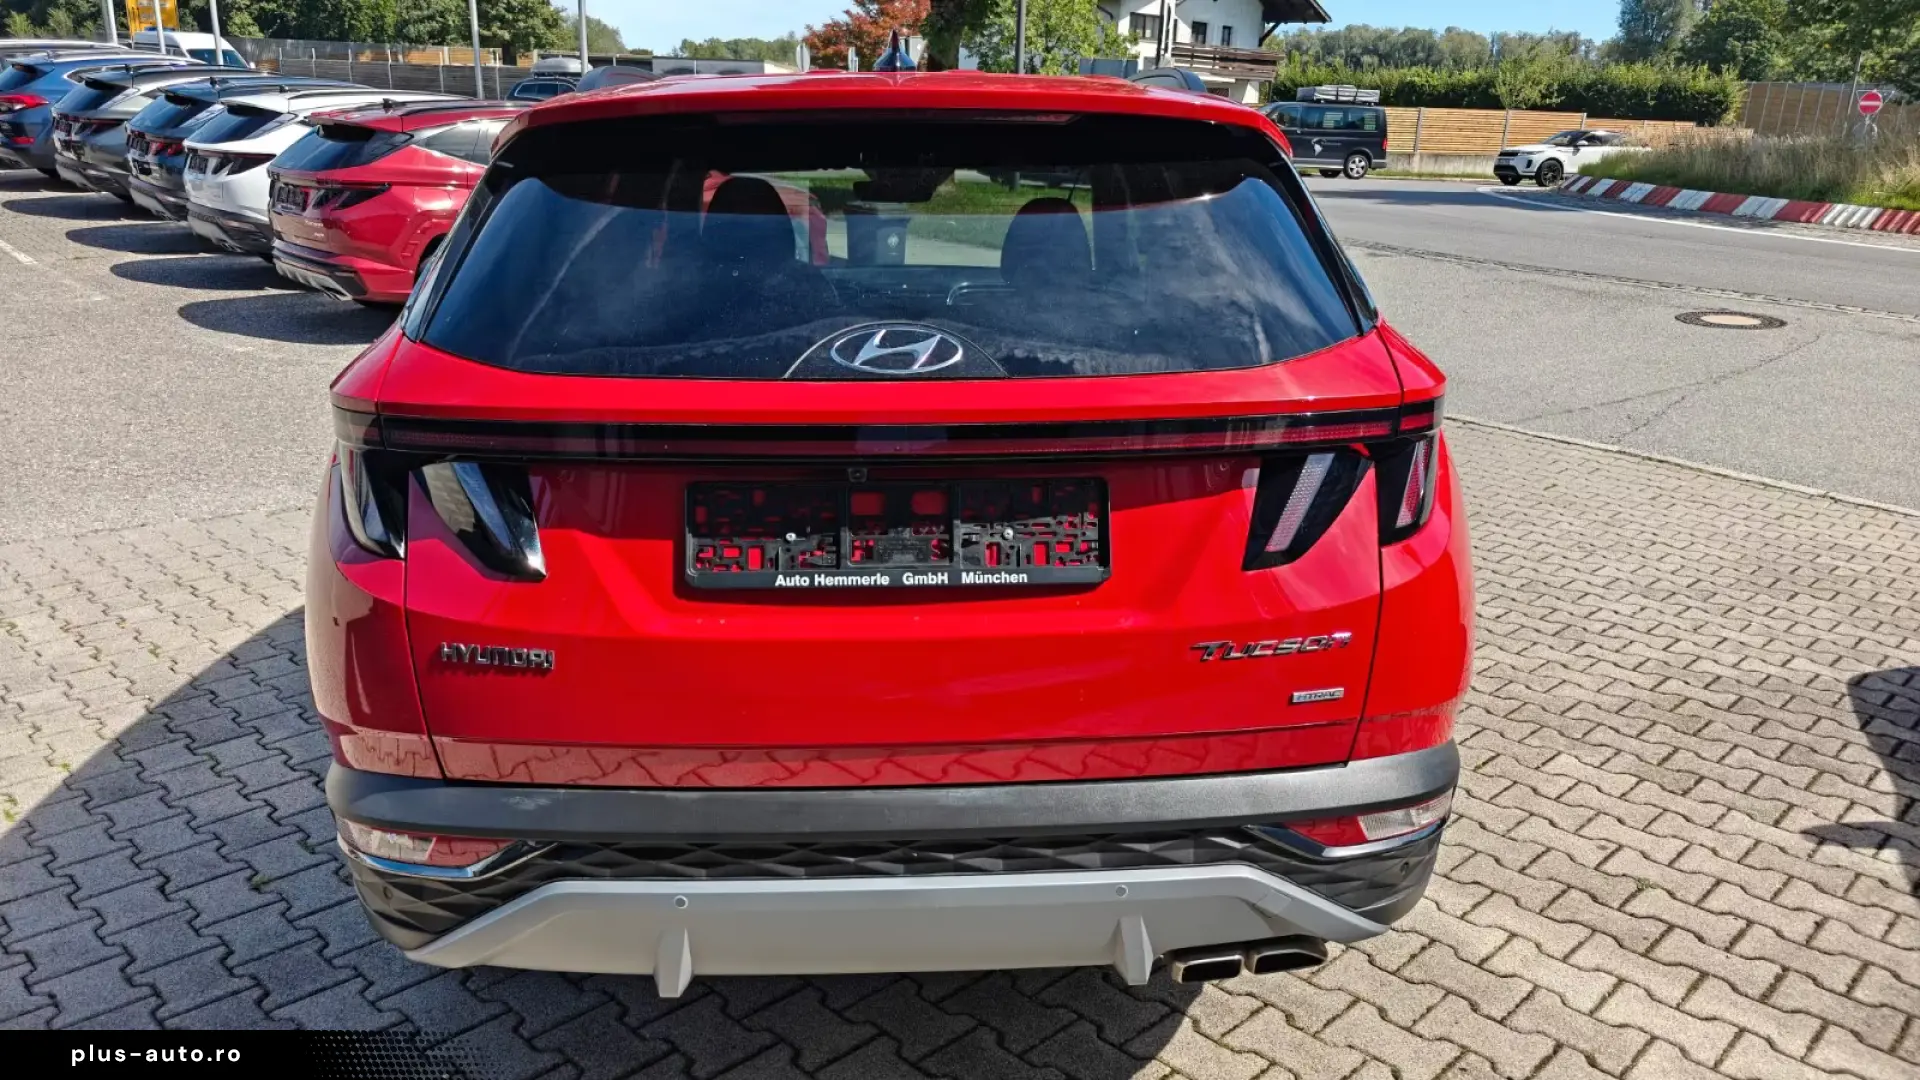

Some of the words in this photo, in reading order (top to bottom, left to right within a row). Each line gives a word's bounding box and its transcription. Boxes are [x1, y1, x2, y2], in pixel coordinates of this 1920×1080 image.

[775, 573, 810, 587] Auto
[814, 572, 890, 586] Hemmerle
[902, 572, 949, 585] GmbH
[961, 571, 1028, 584] München
[441, 641, 556, 670] HYUNDAI
[1190, 632, 1352, 661] TUCSON
